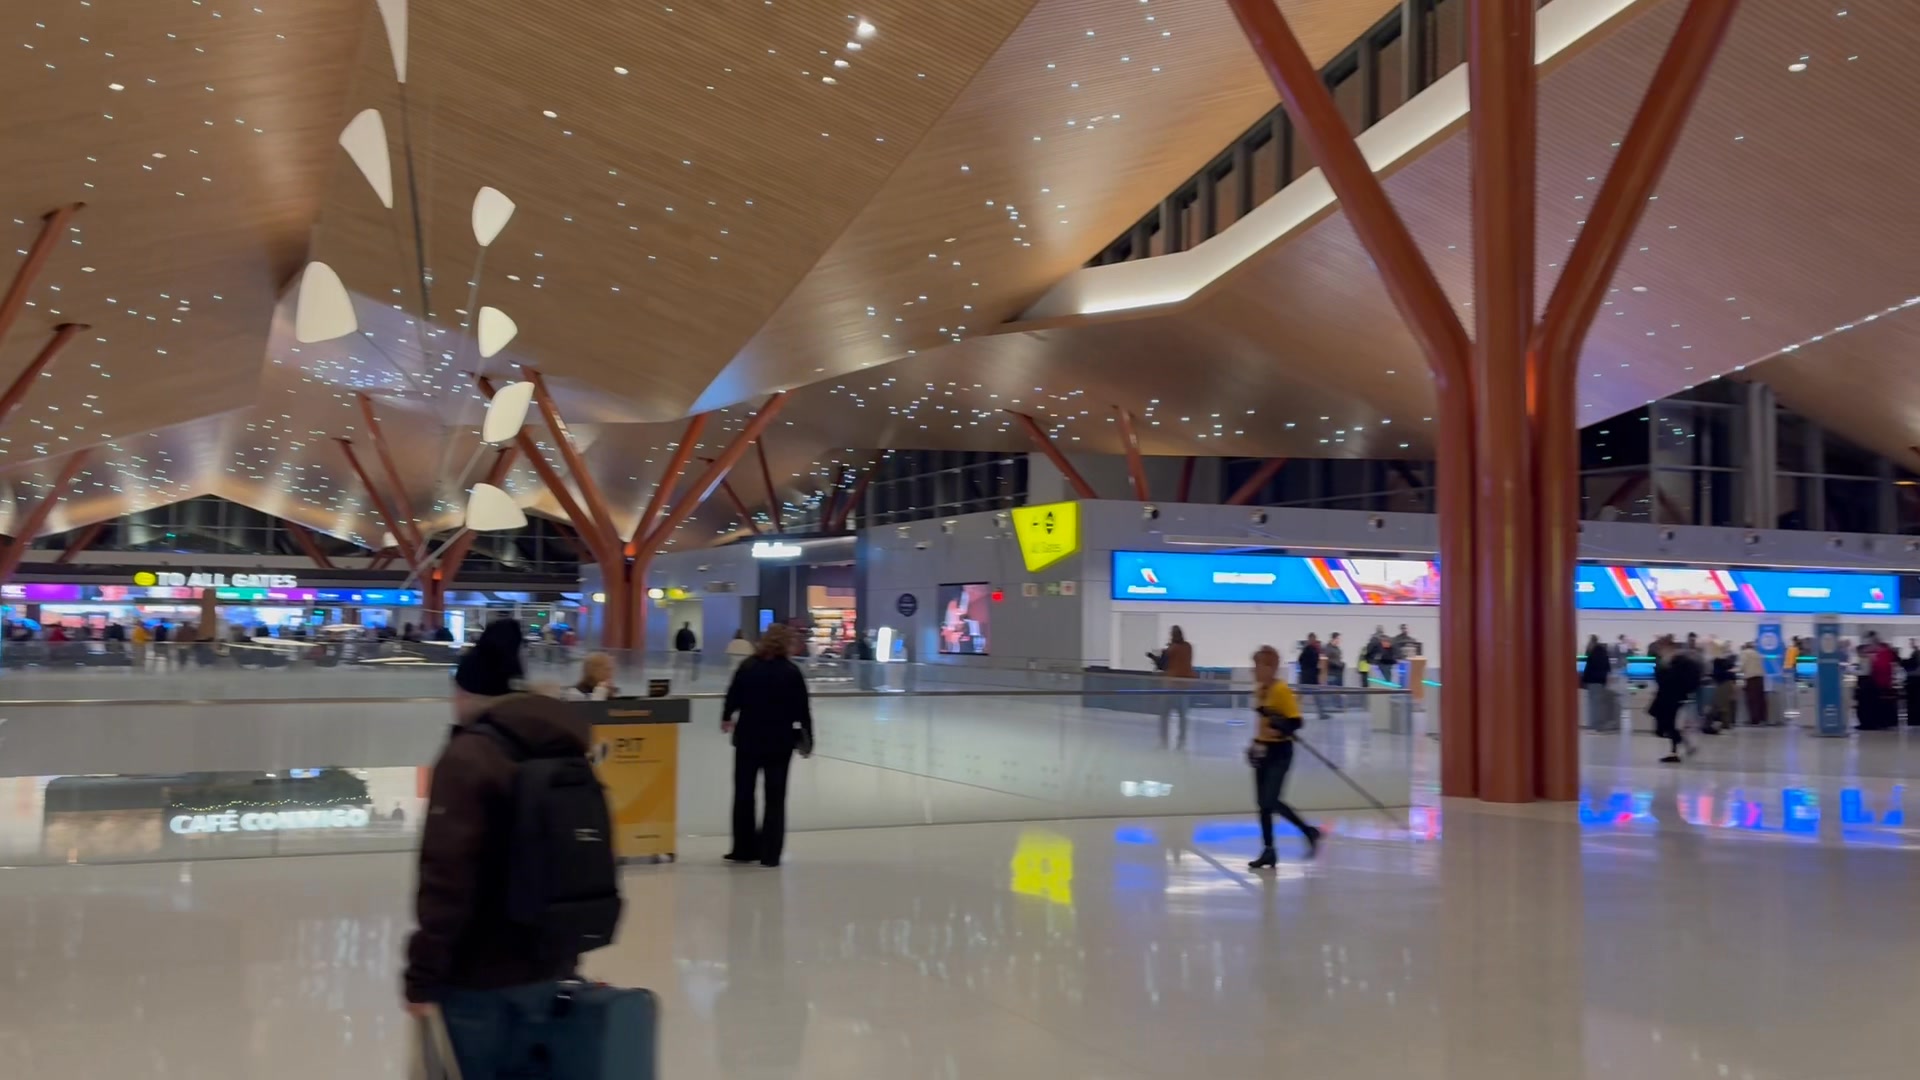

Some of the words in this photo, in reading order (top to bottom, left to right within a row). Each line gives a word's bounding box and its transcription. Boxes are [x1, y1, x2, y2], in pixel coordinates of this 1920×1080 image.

[155, 572, 186, 587] TO
[187, 573, 230, 587] ALL
[231, 573, 298, 588] GATES
[615, 736, 646, 752] PIT
[170, 810, 239, 834] CAFÉ
